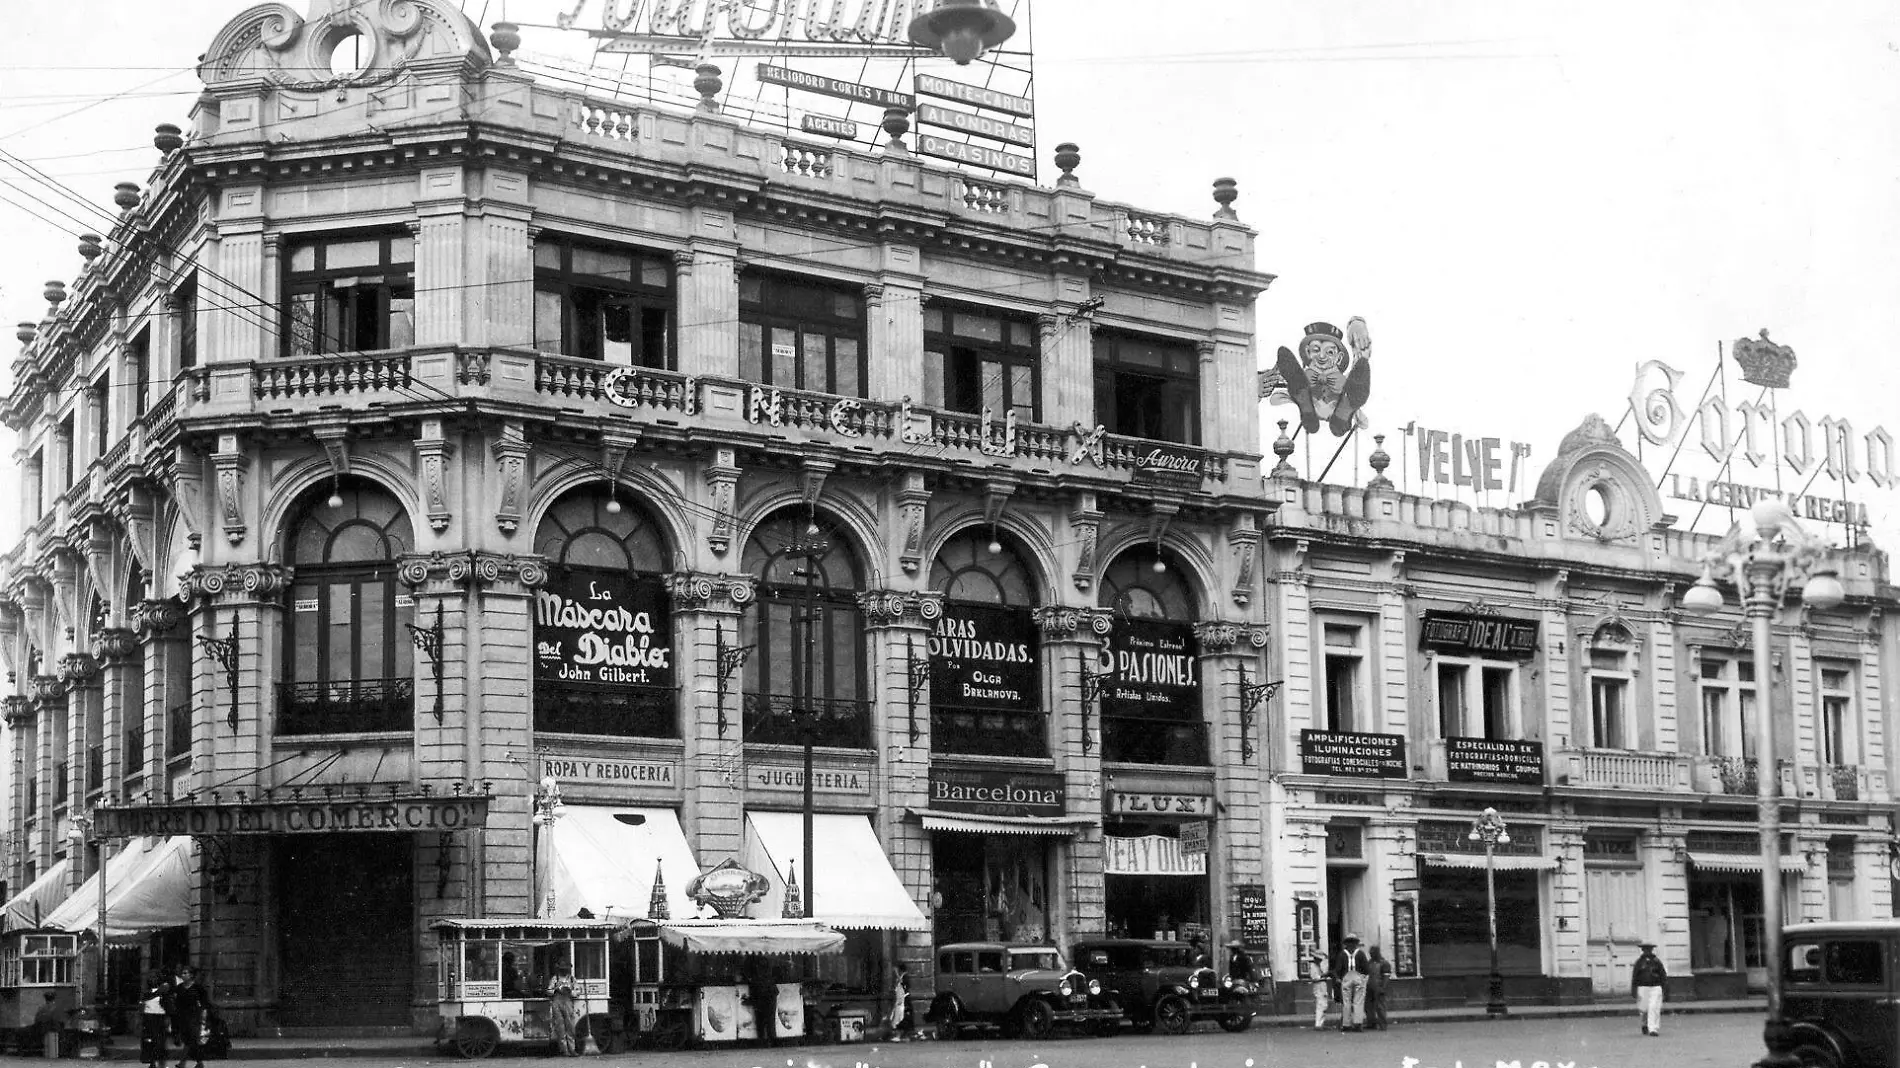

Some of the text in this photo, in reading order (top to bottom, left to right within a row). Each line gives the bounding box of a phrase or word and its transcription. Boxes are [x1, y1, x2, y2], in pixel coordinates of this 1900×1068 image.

[767, 66, 825, 88] HELIODORO
[832, 80, 871, 98] CORTES
[876, 89, 883, 101] Y
[920, 76, 1031, 112] MONTE-CARLO
[808, 117, 855, 135] AGENTES
[928, 108, 1030, 143] ALONDRAS
[926, 138, 1030, 172] O-CASINOS
[1628, 360, 1900, 490] Corona
[1136, 449, 1199, 472] Aurora
[1672, 473, 1701, 500] LA
[1805, 495, 1870, 526] REGIA
[590, 581, 611, 600] La
[536, 589, 654, 633] Máscara
[935, 618, 976, 639] ARAS
[538, 641, 561, 656] Del
[574, 631, 670, 668] Diablo.
[928, 637, 1033, 663] OLVIDADAS.
[559, 663, 650, 682] John Gilbert.
[1120, 650, 1197, 686] PASIONES.
[1308, 734, 1398, 746] AMPLIFICACIONES
[1314, 745, 1392, 756] ILUMINACIONES
[1457, 741, 1515, 752] ESPECIALIDAD
[1304, 756, 1341, 765] FOTOGRAFIAS
[1343, 758, 1379, 767] COMERCIALES
[1450, 751, 1500, 761] FOTOGRAFIAS
[1504, 754, 1541, 764] DOMICILIO
[1450, 762, 1459, 770] DE
[1460, 762, 1499, 771] MATRIMONIOS
[1506, 764, 1510, 772] Y
[545, 761, 670, 781] ROPA Y REBOCERIA
[758, 771, 863, 789] JUGUTERIA.
[931, 780, 1063, 803] "Barcelona"
[217, 807, 272, 832] DEL
